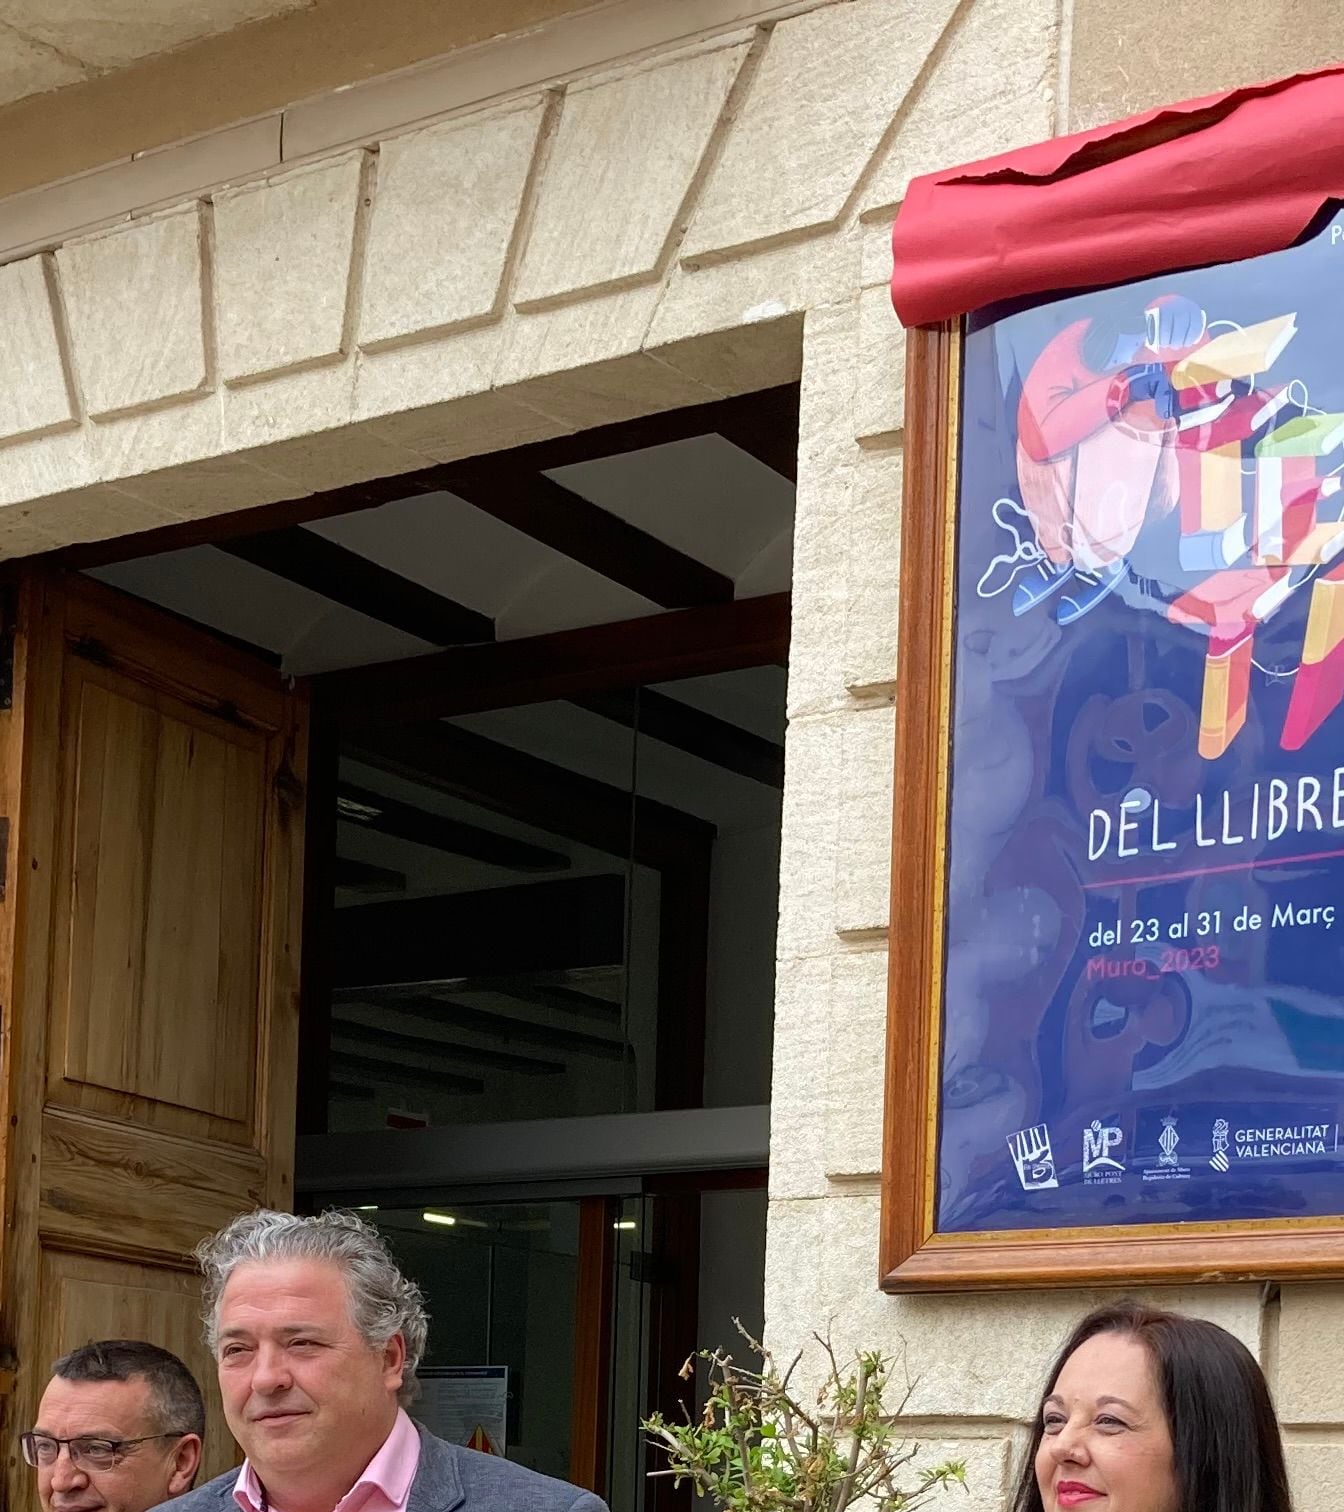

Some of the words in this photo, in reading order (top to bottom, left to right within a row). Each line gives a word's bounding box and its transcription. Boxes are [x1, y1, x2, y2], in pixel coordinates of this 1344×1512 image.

[1088, 799, 1177, 861] DEL
[1089, 920, 1121, 947] del
[1130, 918, 1159, 943] 23
[1168, 913, 1188, 938] al
[1197, 911, 1220, 936] 31
[1233, 906, 1262, 931] de
[1272, 902, 1335, 930] Març
[1087, 945, 1220, 981] Muro_2023
[1235, 1124, 1329, 1143] GENERALITAT
[1236, 1141, 1326, 1158] VALENCIANA
